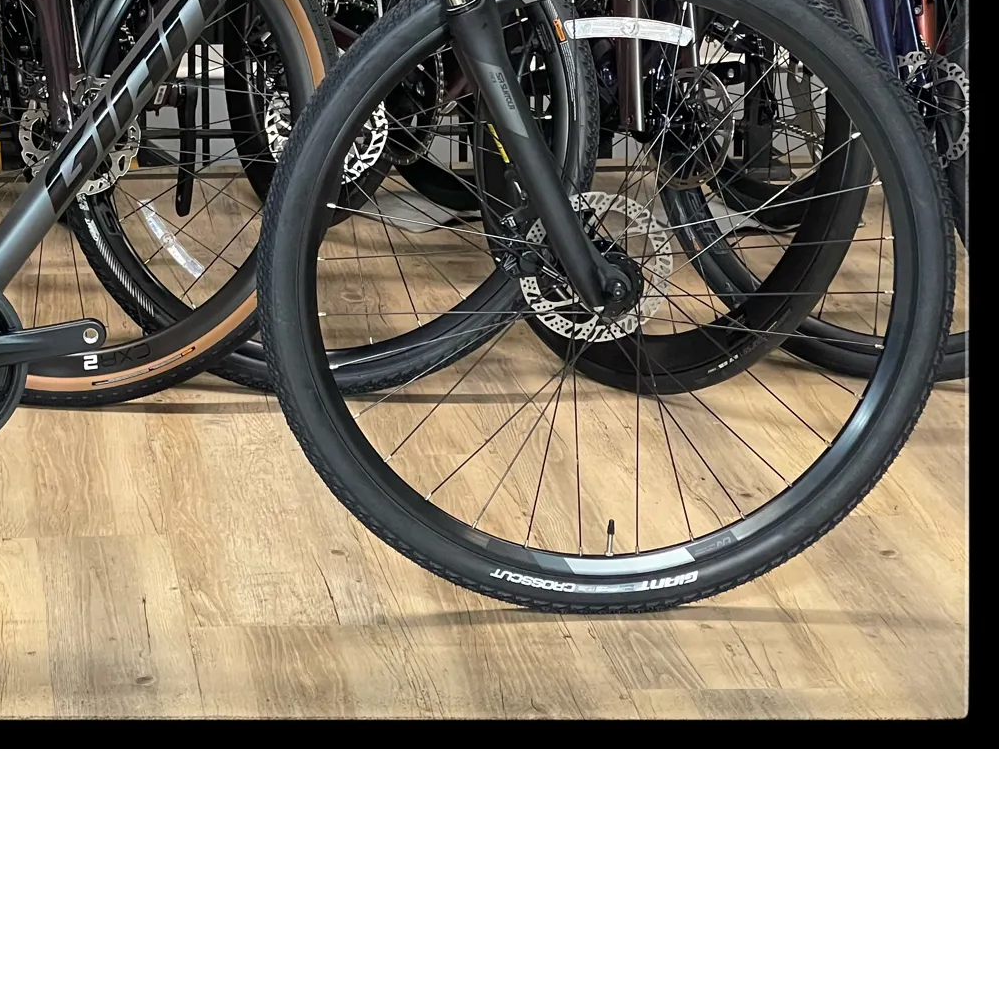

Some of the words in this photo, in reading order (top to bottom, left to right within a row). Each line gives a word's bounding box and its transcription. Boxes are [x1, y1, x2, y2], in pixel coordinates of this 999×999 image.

[500, 84, 516, 110] SUNTOUR
[83, 354, 99, 370] 2
[490, 568, 577, 593] CROSSCUT
[642, 570, 699, 591] GIANT
